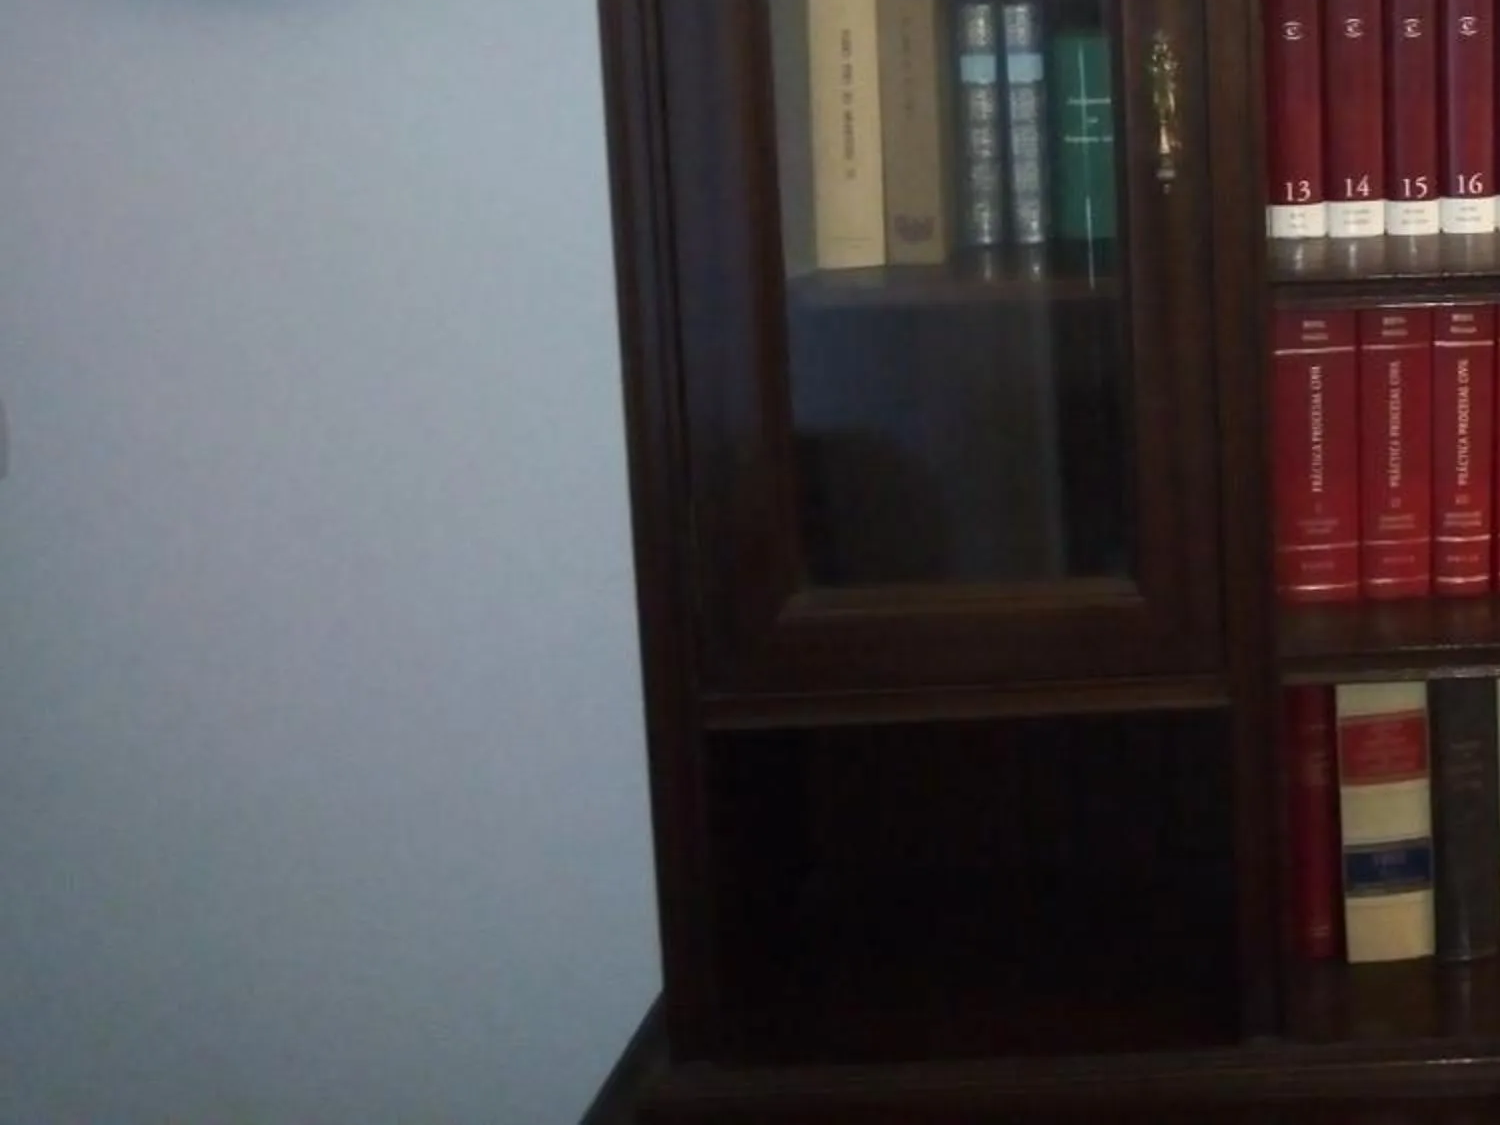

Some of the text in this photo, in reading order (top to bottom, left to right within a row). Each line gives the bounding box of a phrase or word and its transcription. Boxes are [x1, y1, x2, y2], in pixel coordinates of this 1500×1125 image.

[1284, 181, 1311, 201] 13
[1344, 177, 1370, 198] 14
[1402, 177, 1428, 198] 15
[1457, 173, 1483, 194] 16
